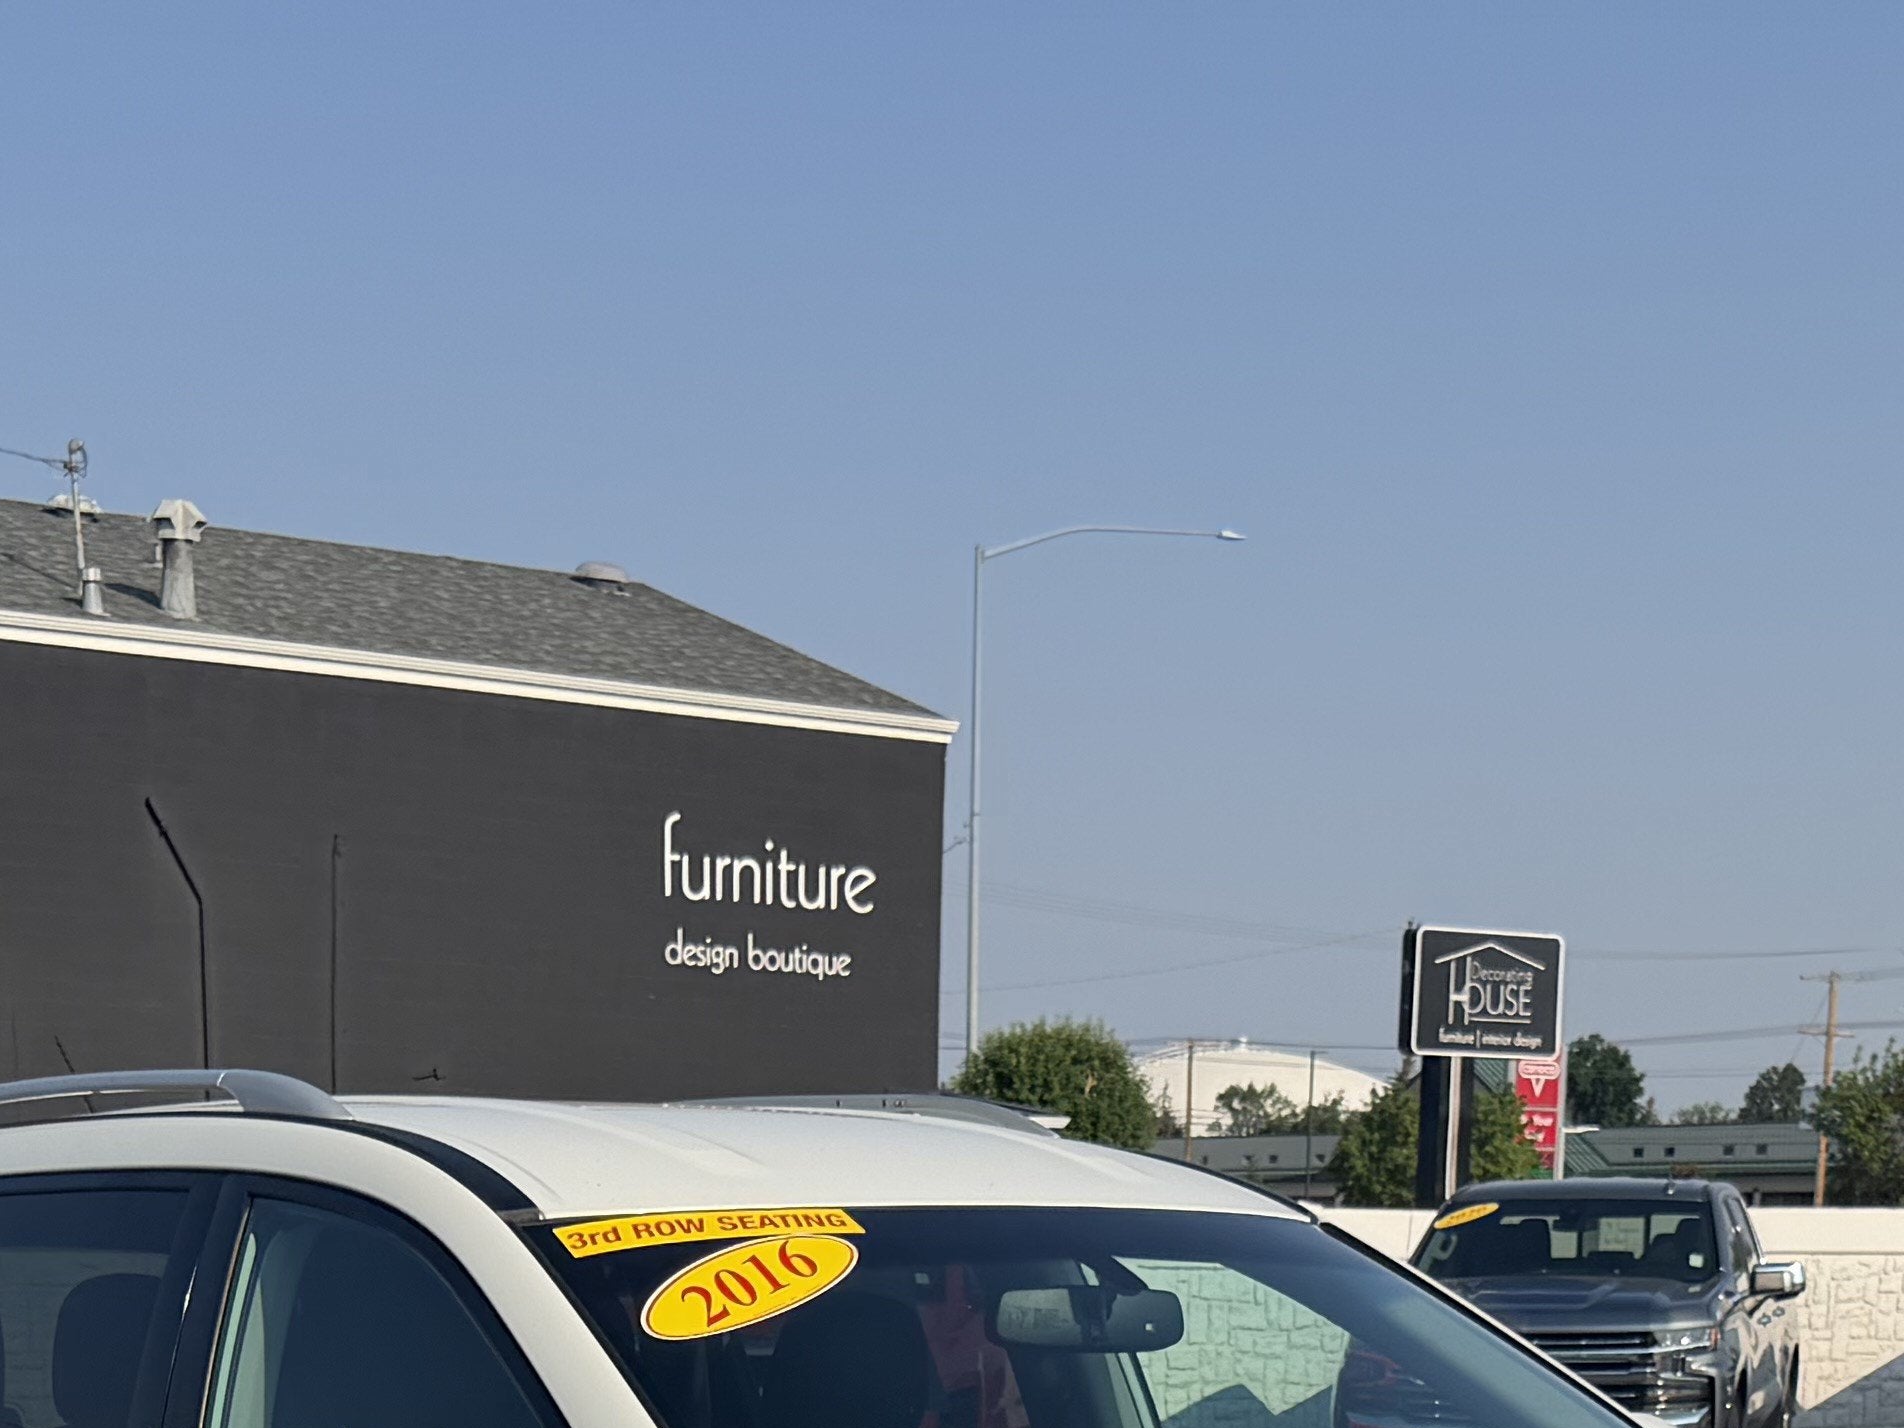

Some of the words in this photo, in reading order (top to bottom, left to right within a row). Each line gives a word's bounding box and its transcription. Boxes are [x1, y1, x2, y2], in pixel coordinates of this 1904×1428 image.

[663, 810, 877, 914] furniture
[664, 926, 739, 974] design
[747, 932, 852, 981] boutique
[1470, 961, 1534, 986] Decorating
[1447, 955, 1533, 1025] HOUSE
[566, 1227, 622, 1250] 3rd
[631, 1217, 706, 1240] ROW
[716, 1212, 848, 1231] SEATING
[680, 1239, 819, 1328] 2016
